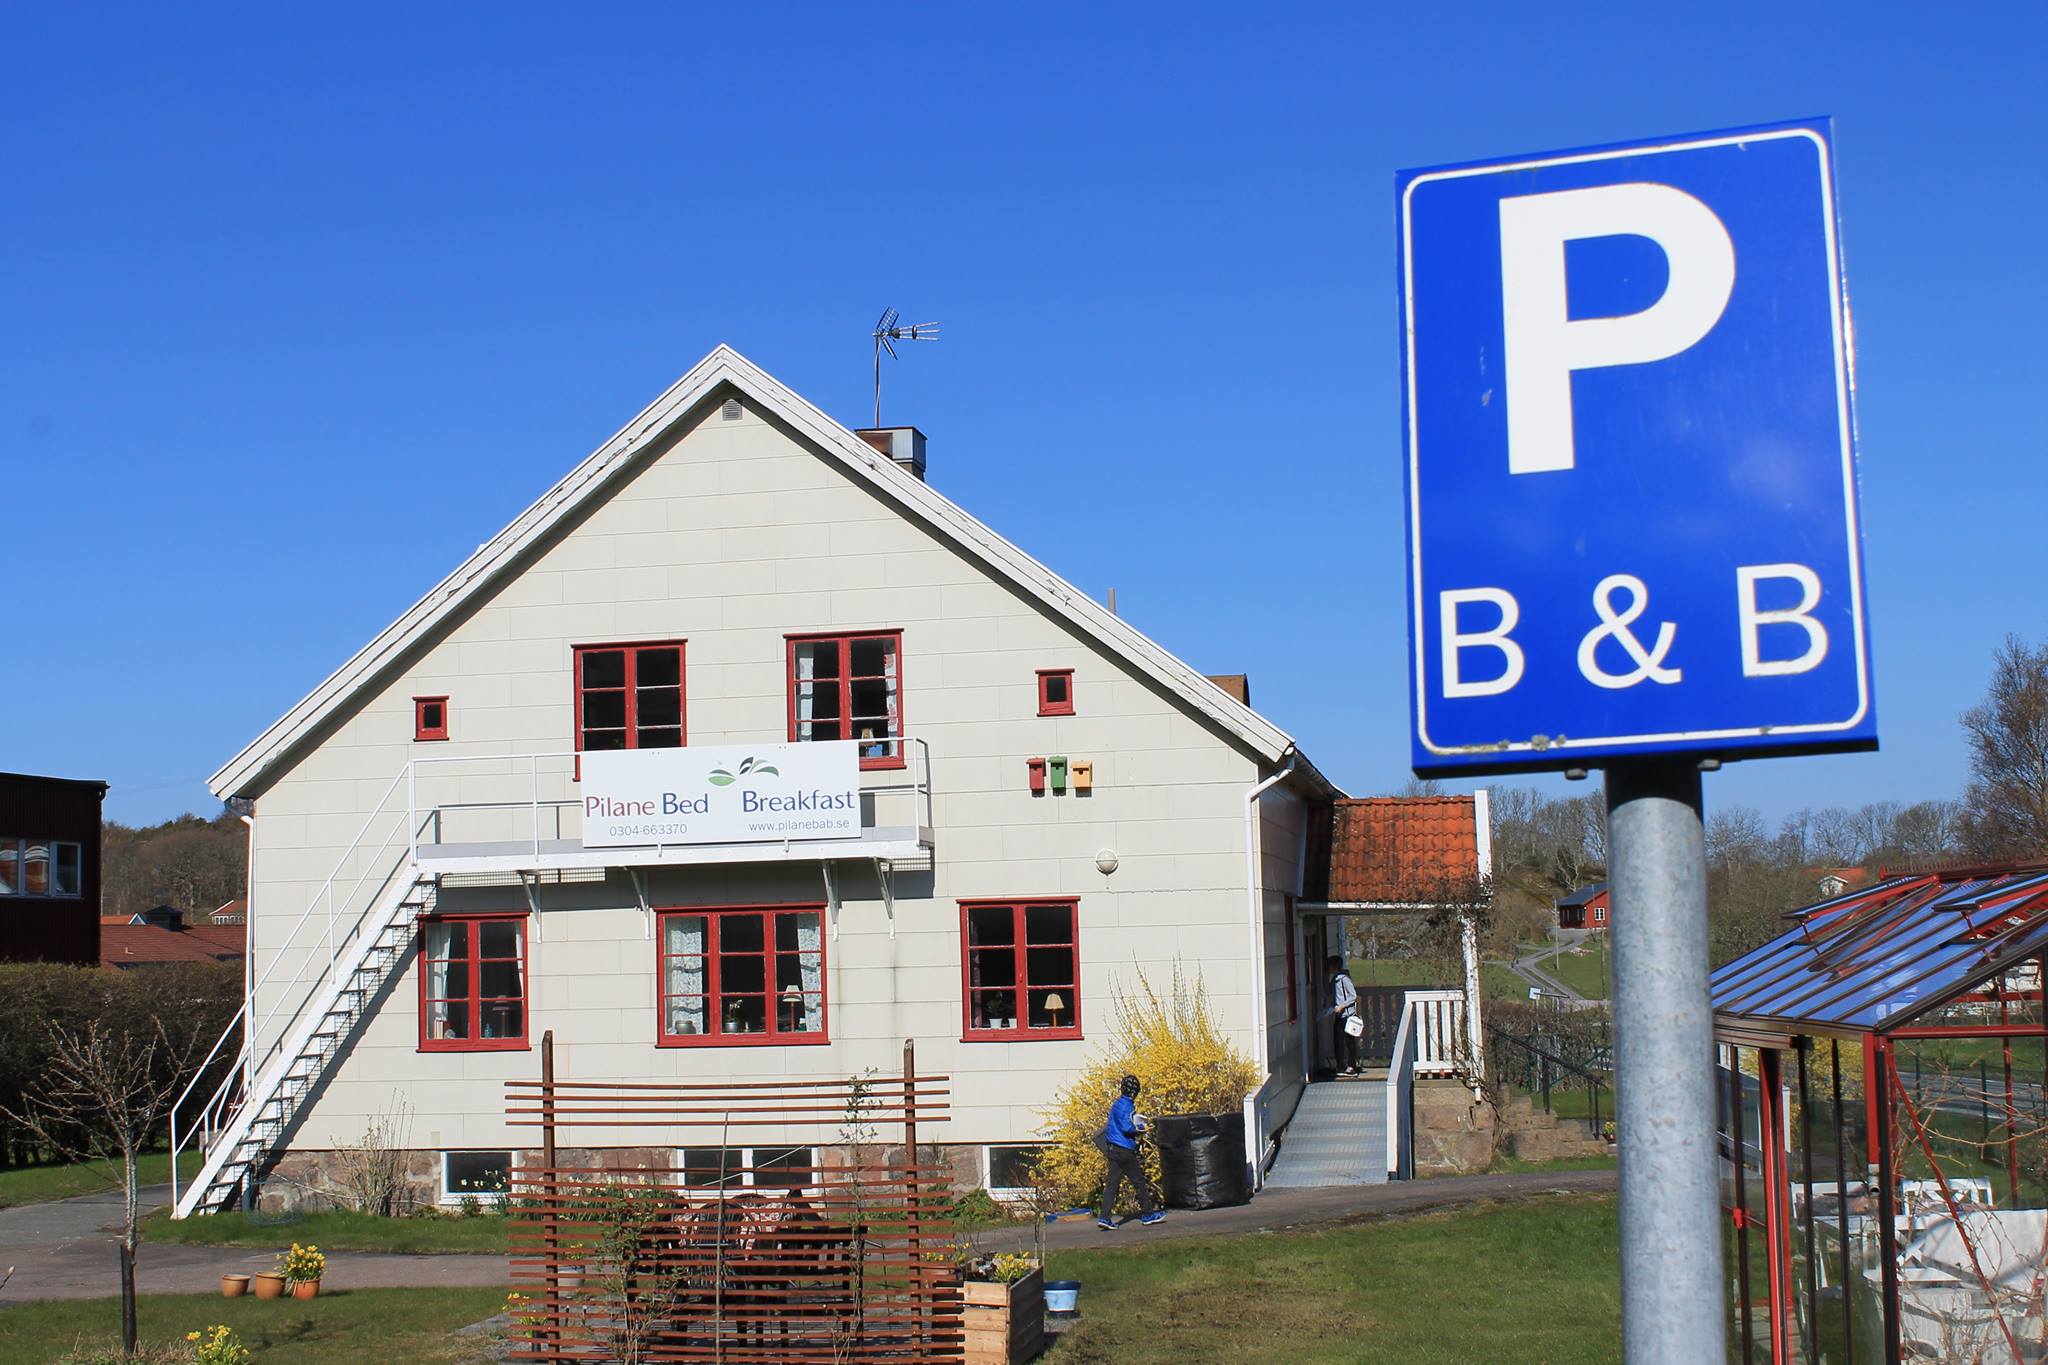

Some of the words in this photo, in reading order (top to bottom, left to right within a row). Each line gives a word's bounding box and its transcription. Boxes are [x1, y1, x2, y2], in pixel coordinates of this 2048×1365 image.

[1499, 182, 1735, 475] P
[1440, 586, 1525, 699] B
[1576, 574, 1682, 689] &
[1736, 562, 1828, 678] B
[586, 795, 656, 818] Pilane
[662, 792, 709, 816] Bed
[742, 789, 856, 813] Breakfast
[609, 823, 688, 837] 0304-663370
[749, 818, 850, 833] www.pilanebab.se
